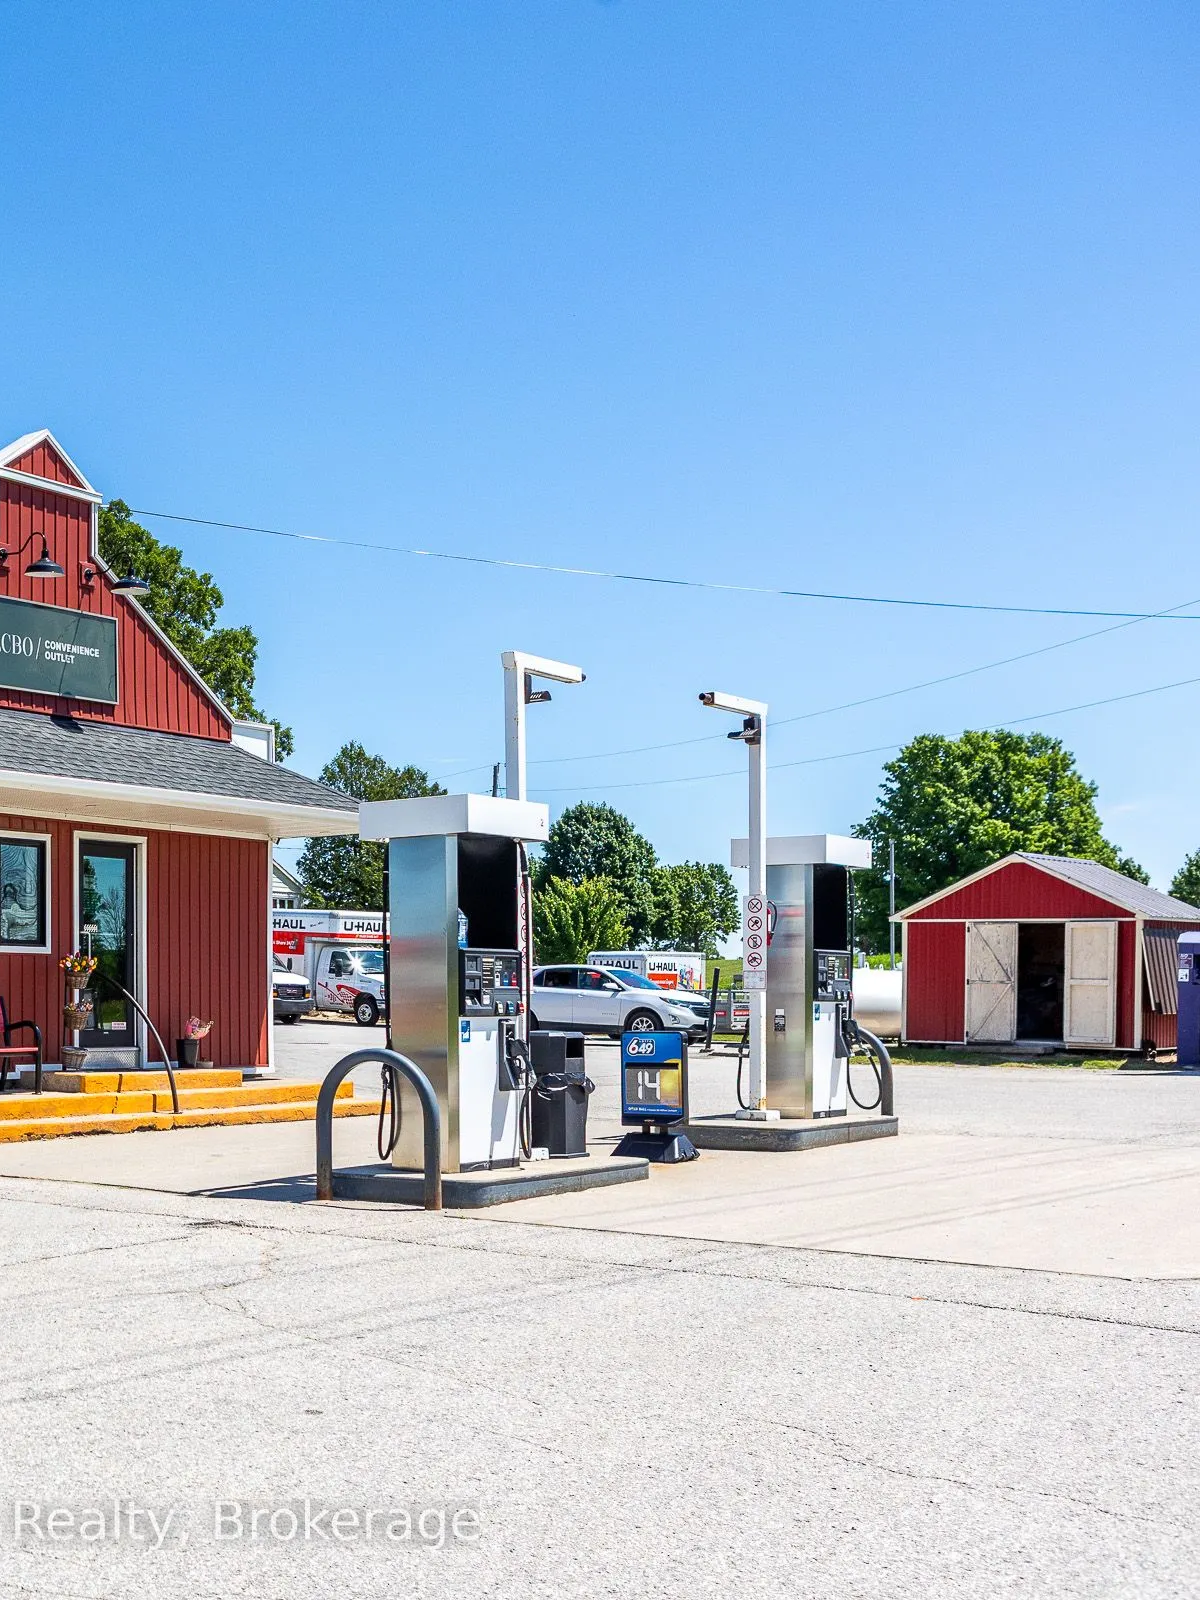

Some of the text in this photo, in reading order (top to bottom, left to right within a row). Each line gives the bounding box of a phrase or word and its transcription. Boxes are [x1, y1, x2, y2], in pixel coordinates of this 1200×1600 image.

[44, 639, 100, 658] CONVENIENCE
[44, 651, 75, 664] OUTLET
[273, 918, 306, 929] -HAUL
[344, 921, 386, 932] U-HAU
[649, 962, 678, 971] U-HAUL
[637, 1070, 661, 1100] 14
